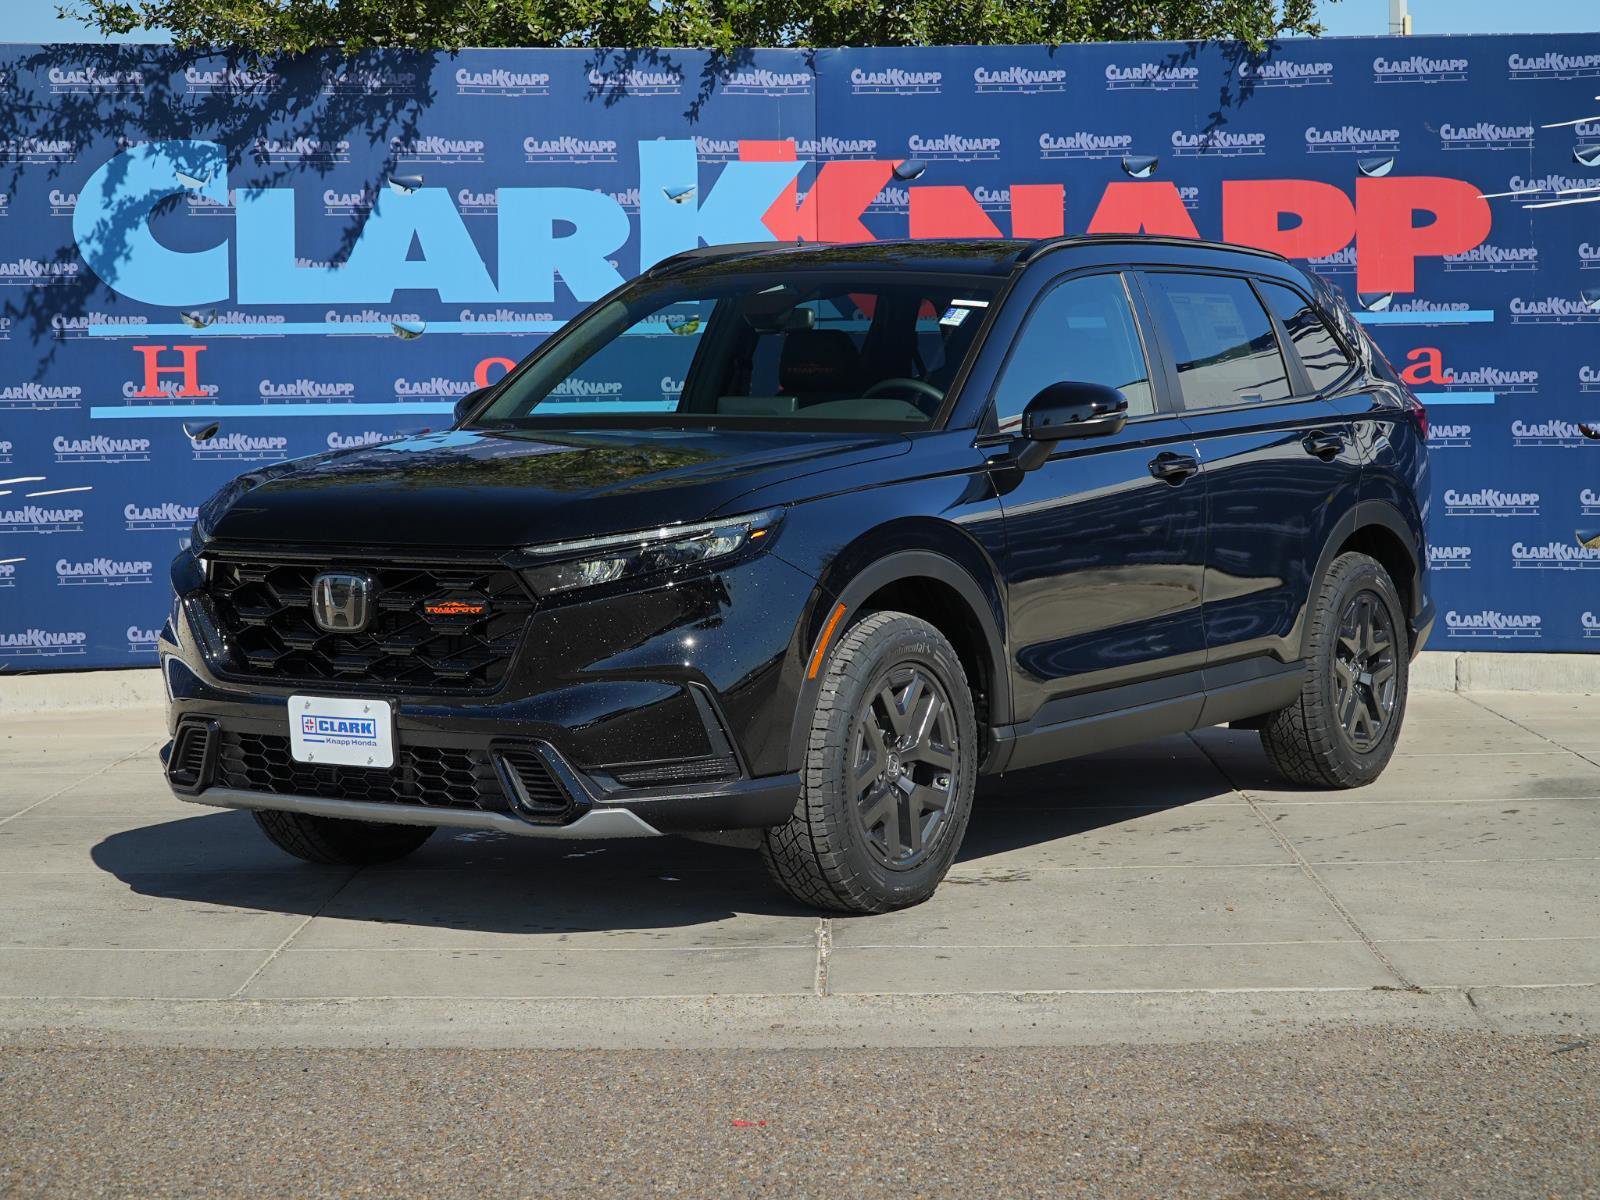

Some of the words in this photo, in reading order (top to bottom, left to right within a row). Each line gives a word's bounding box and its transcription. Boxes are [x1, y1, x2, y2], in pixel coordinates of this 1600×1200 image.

[1373, 56, 1468, 74] CLARKKNAPP
[456, 69, 549, 87] CLARKKNAPP
[851, 68, 941, 86] CLARKKNAPP
[974, 67, 1066, 85] CLARKKNAPP
[1305, 126, 1399, 144] CLARKKNAPP
[1440, 122, 1535, 140] CLARKKNAPP
[523, 136, 617, 154] CLARKKNAPP
[908, 134, 1000, 152] CLARKKNAPP
[1039, 132, 1132, 150] CLARKKNAPP
[0, 259, 78, 277] ARKKNAPP
[0, 382, 81, 400] ARKKNAPP
[259, 379, 354, 397] CLARKKNAPP
[394, 377, 477, 396] CLARKKNAP
[53, 435, 150, 454] CLARKKNAPP
[1443, 489, 1539, 507] CLARKKNAPP
[0, 505, 83, 523] LARKKNAPP
[124, 503, 199, 521] CLARKKNA
[56, 558, 152, 576] CLARKKNAPP
[1445, 610, 1541, 628] CLARKKNAPP
[0, 629, 86, 647] LARKKNAPP
[318, 719, 373, 734] CLARK
[325, 737, 351, 746] Knapp
[351, 739, 377, 747] Honda
